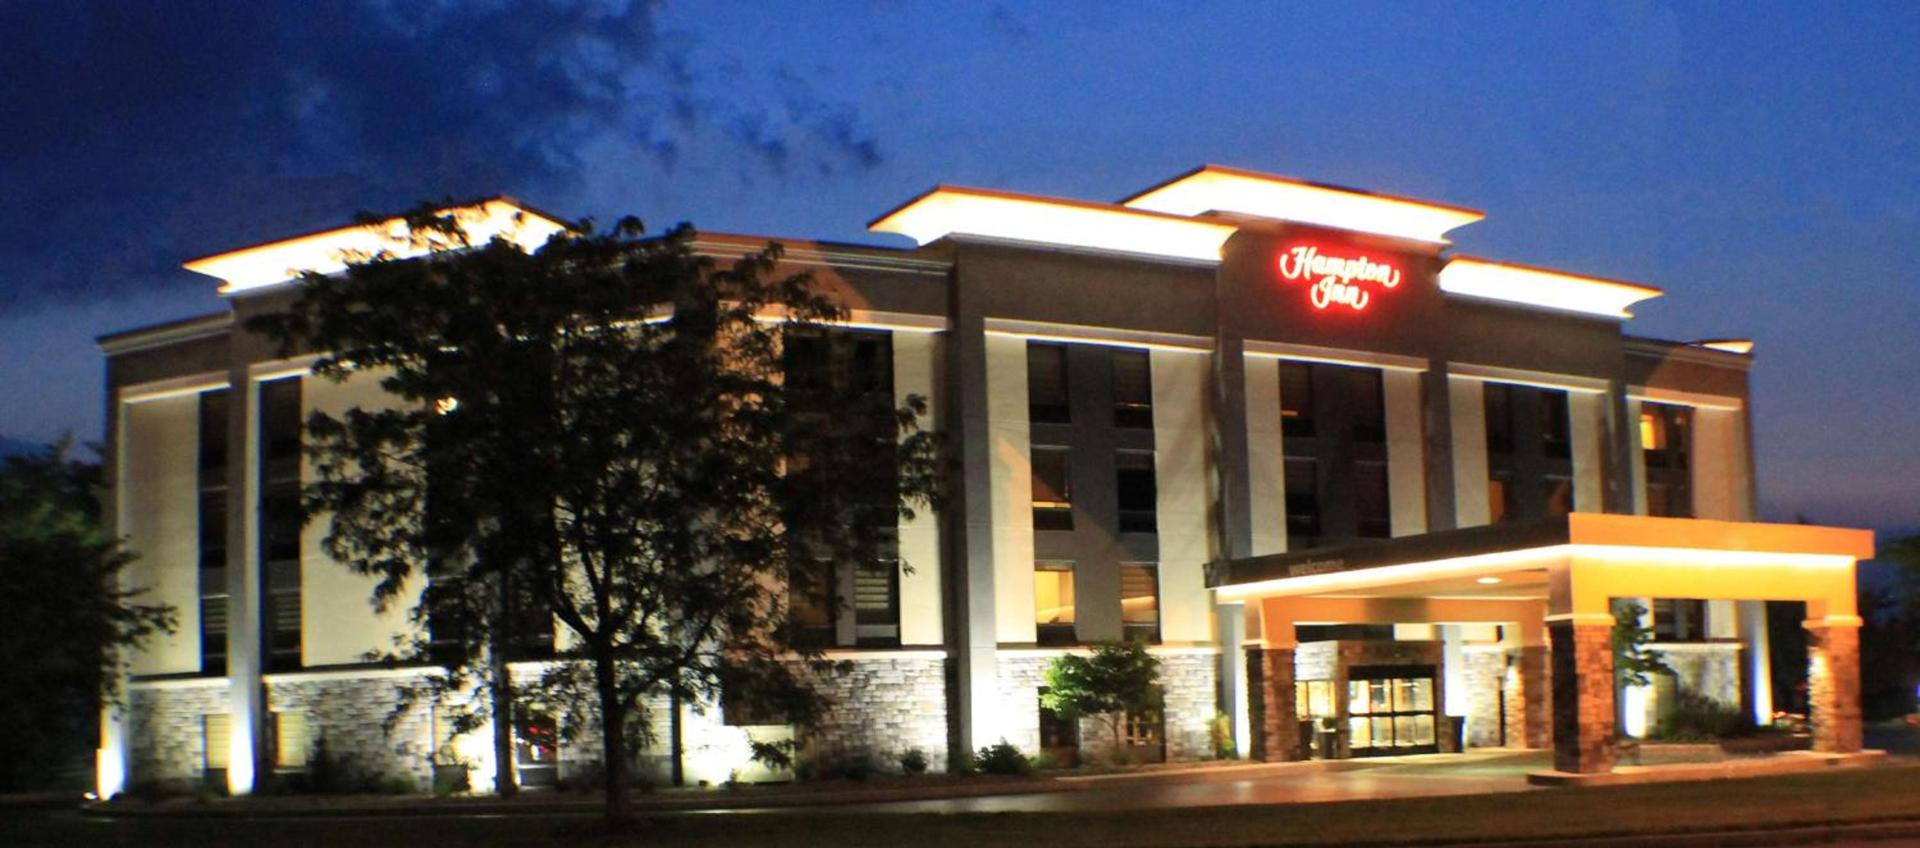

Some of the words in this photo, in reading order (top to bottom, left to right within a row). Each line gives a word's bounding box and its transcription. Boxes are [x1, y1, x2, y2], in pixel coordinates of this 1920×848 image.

[1280, 246, 1400, 288] Hampton
[1311, 275, 1369, 310] Inn
[1288, 558, 1344, 576] welcome
